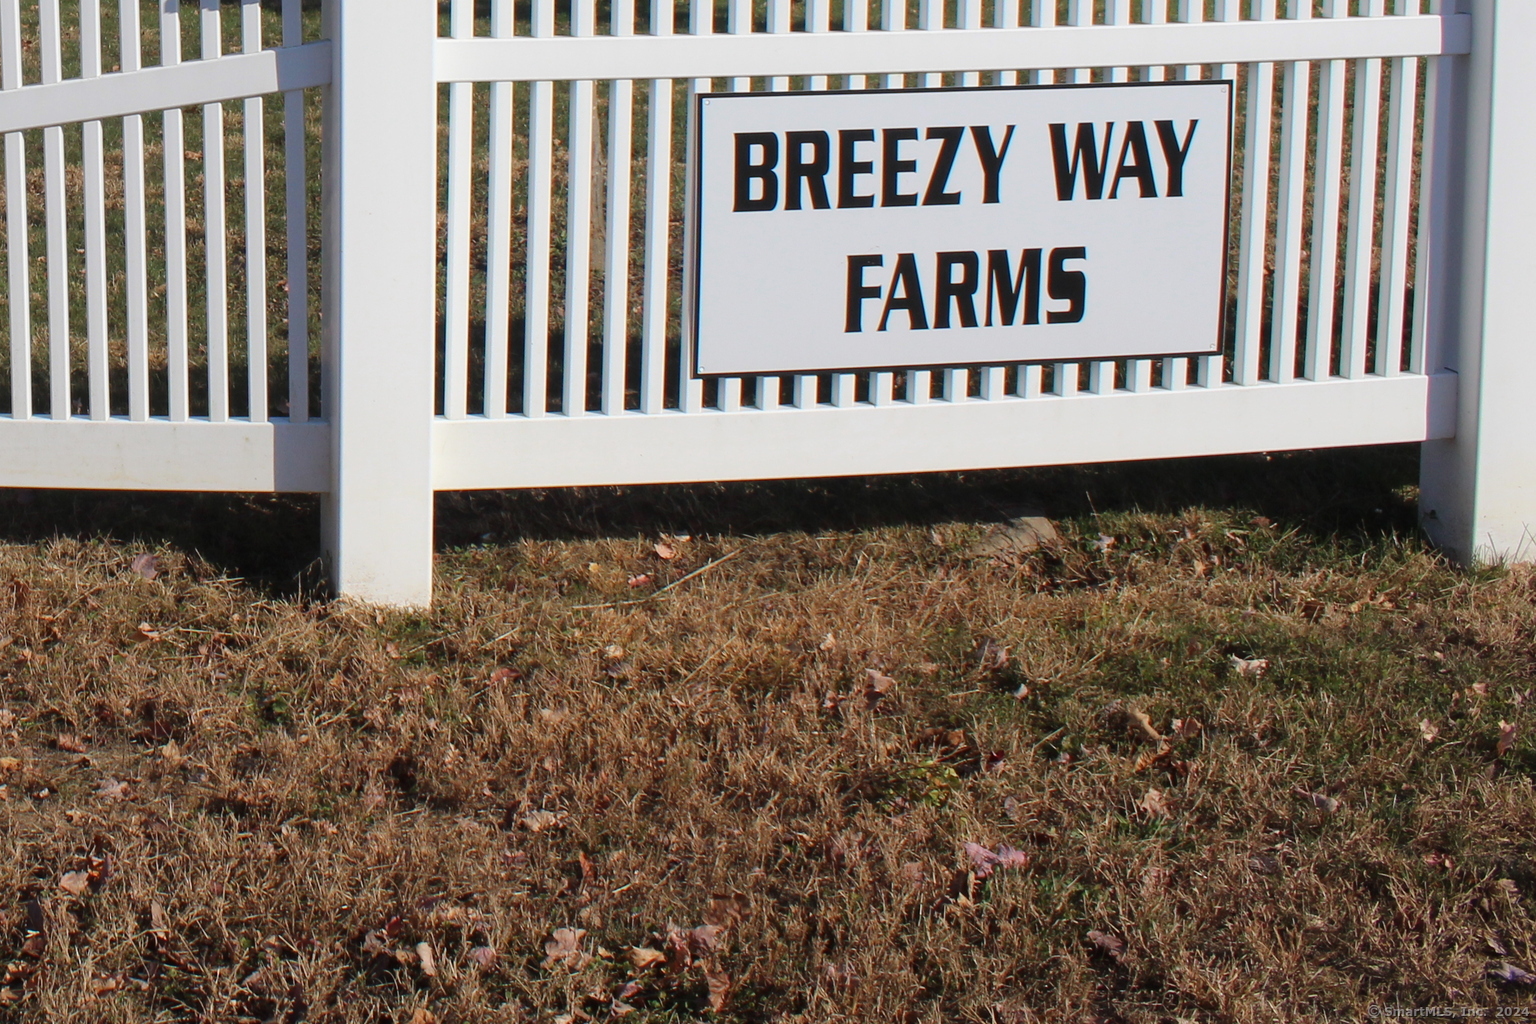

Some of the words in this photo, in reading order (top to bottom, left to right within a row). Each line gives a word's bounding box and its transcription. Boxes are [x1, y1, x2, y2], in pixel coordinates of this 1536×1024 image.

[734, 125, 1015, 212] BREEZY
[1049, 120, 1198, 200] WAY
[845, 247, 1086, 333] FARMS
